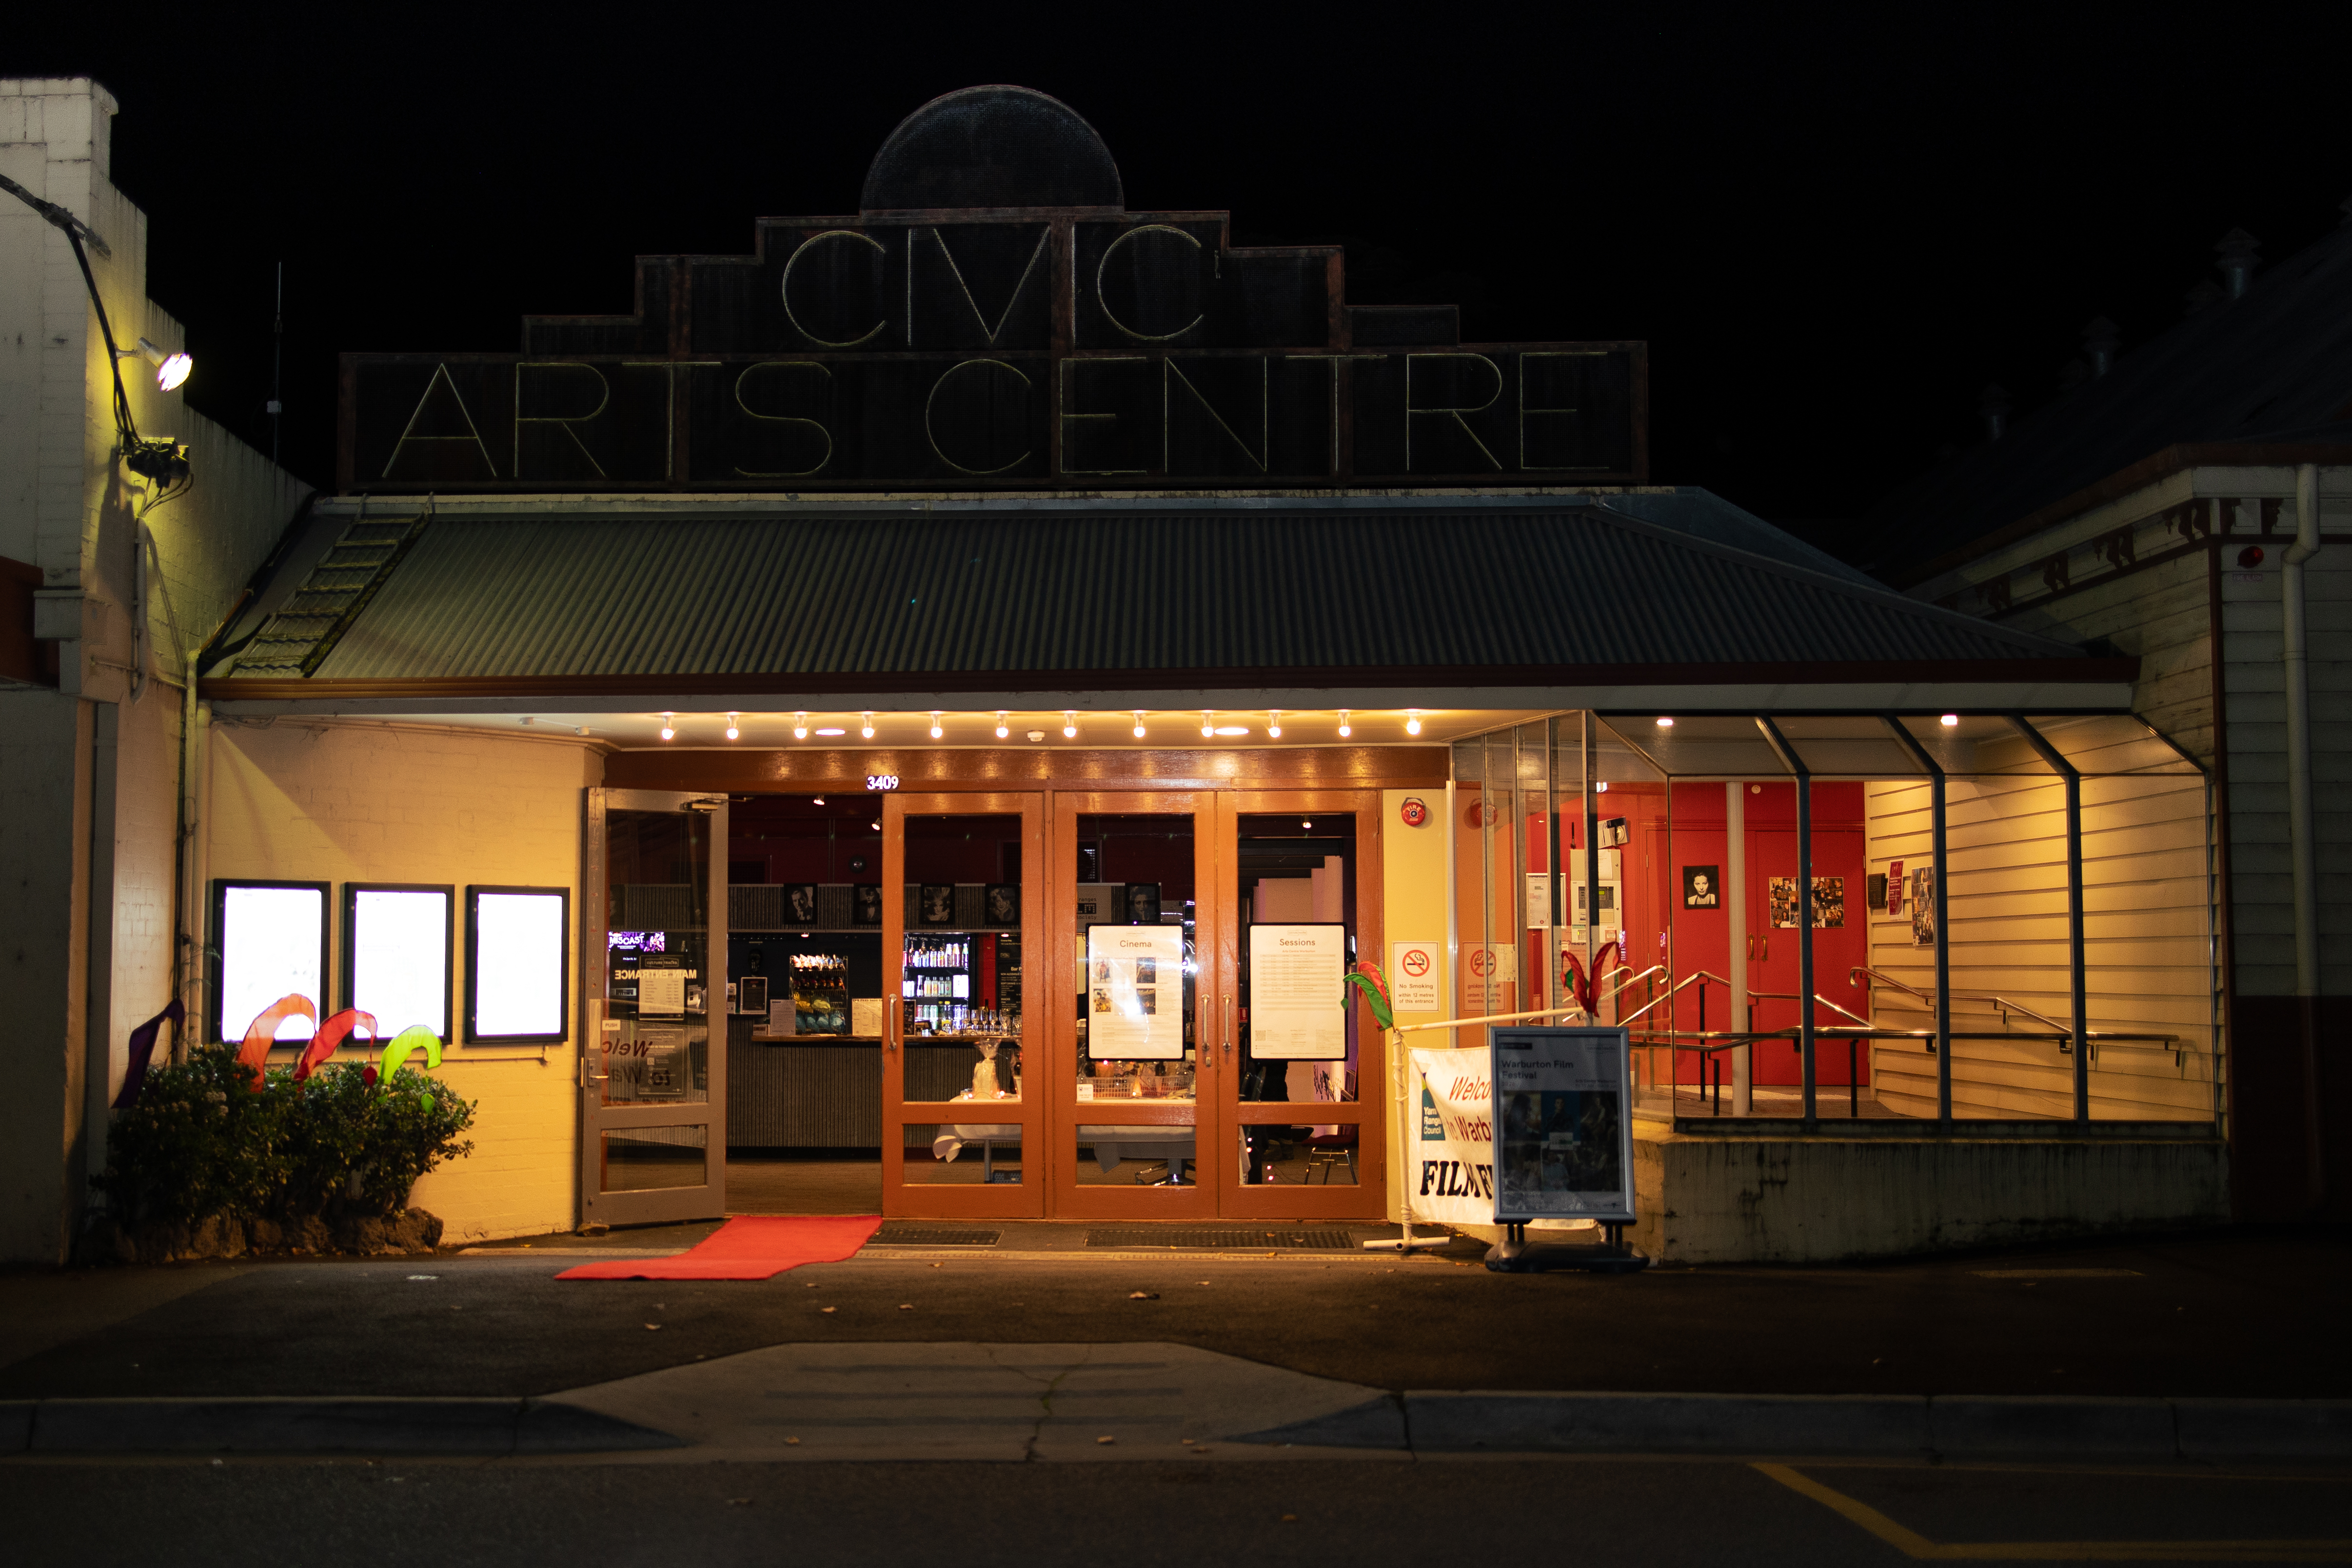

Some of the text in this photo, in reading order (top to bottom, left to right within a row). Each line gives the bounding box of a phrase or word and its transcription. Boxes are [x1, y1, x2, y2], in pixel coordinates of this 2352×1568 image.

[782, 224, 1205, 347] CIVIC
[381, 352, 1610, 478] ARTS CENTRE
[867, 775, 899, 790] 3409
[609, 936, 645, 945] MISCAST
[1501, 1059, 1574, 1069] Warburton Film
[1502, 1071, 1537, 1079] Festival
[1448, 1075, 1491, 1101] Welco
[1423, 1126, 1442, 1135] Council
[1454, 1115, 1491, 1142] Warb
[1420, 1160, 1481, 1198] FILM
